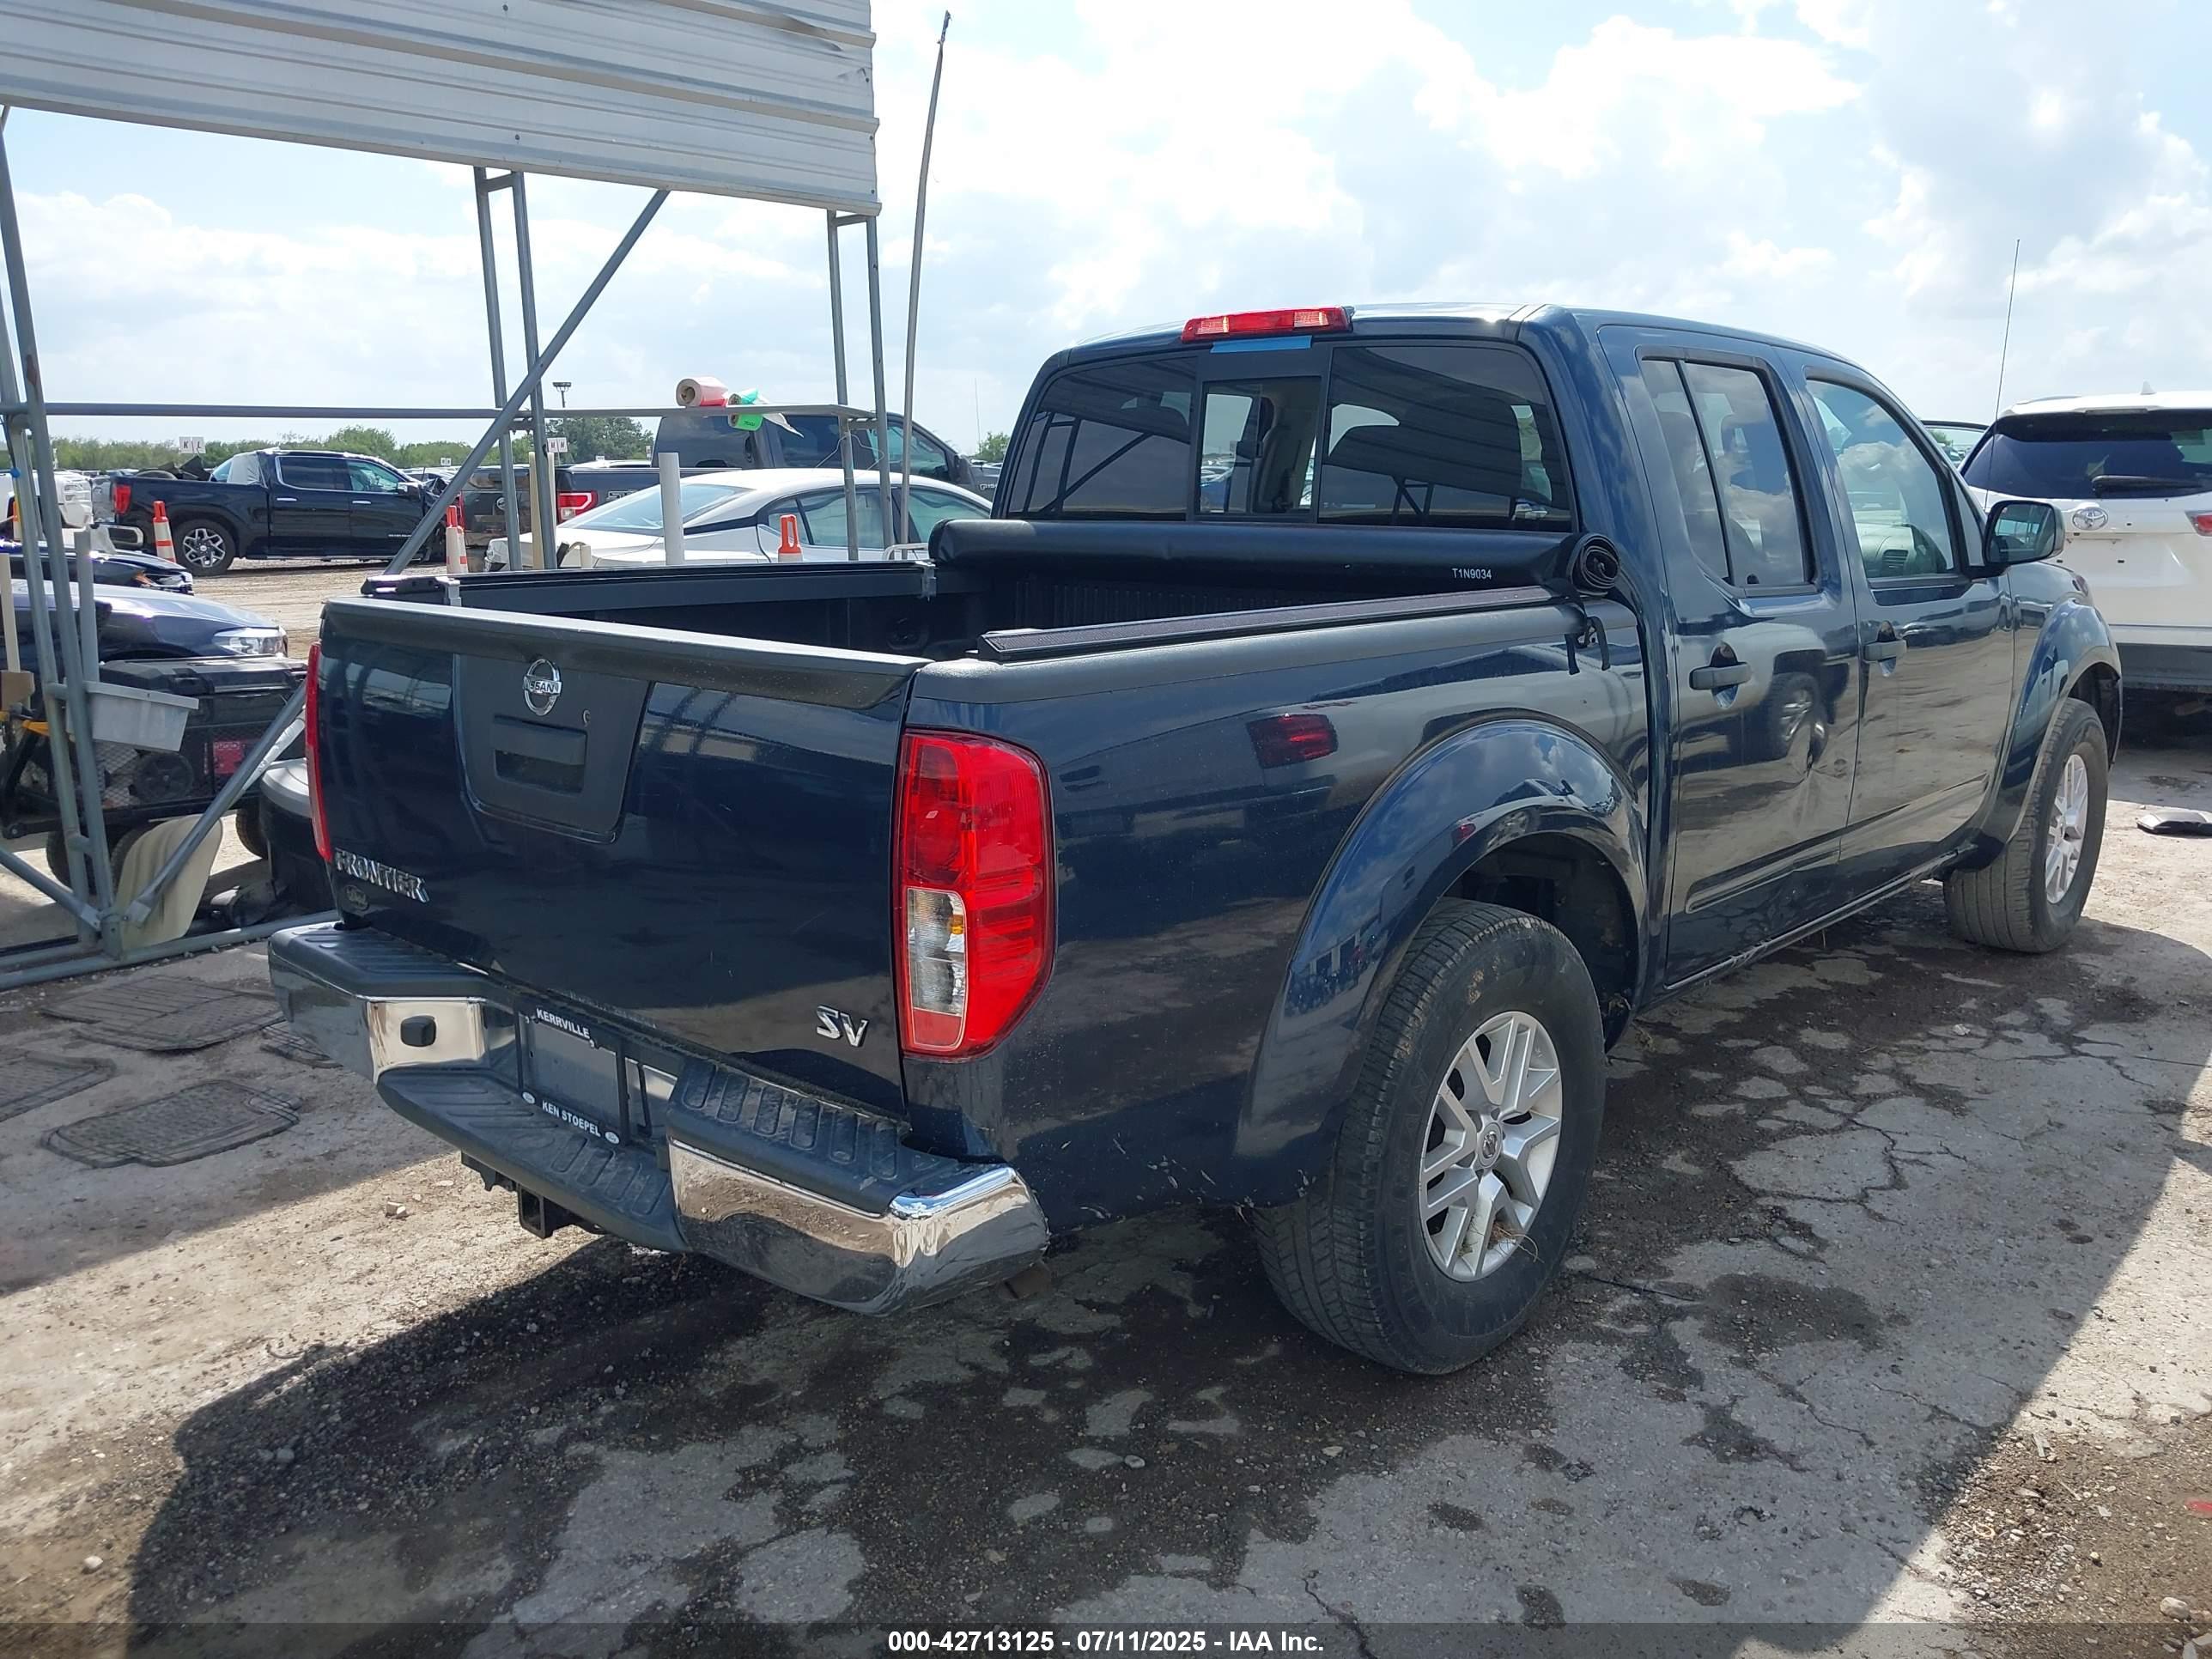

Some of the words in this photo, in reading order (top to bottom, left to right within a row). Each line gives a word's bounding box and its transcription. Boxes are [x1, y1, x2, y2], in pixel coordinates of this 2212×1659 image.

[1451, 568, 1492, 580] T1N9034
[335, 847, 428, 902] FRONTIER
[536, 1007, 590, 1039] KERRVILLE
[817, 1005, 868, 1047] SV
[542, 1101, 559, 1117] KEN
[562, 1110, 601, 1137] STOEPEL
